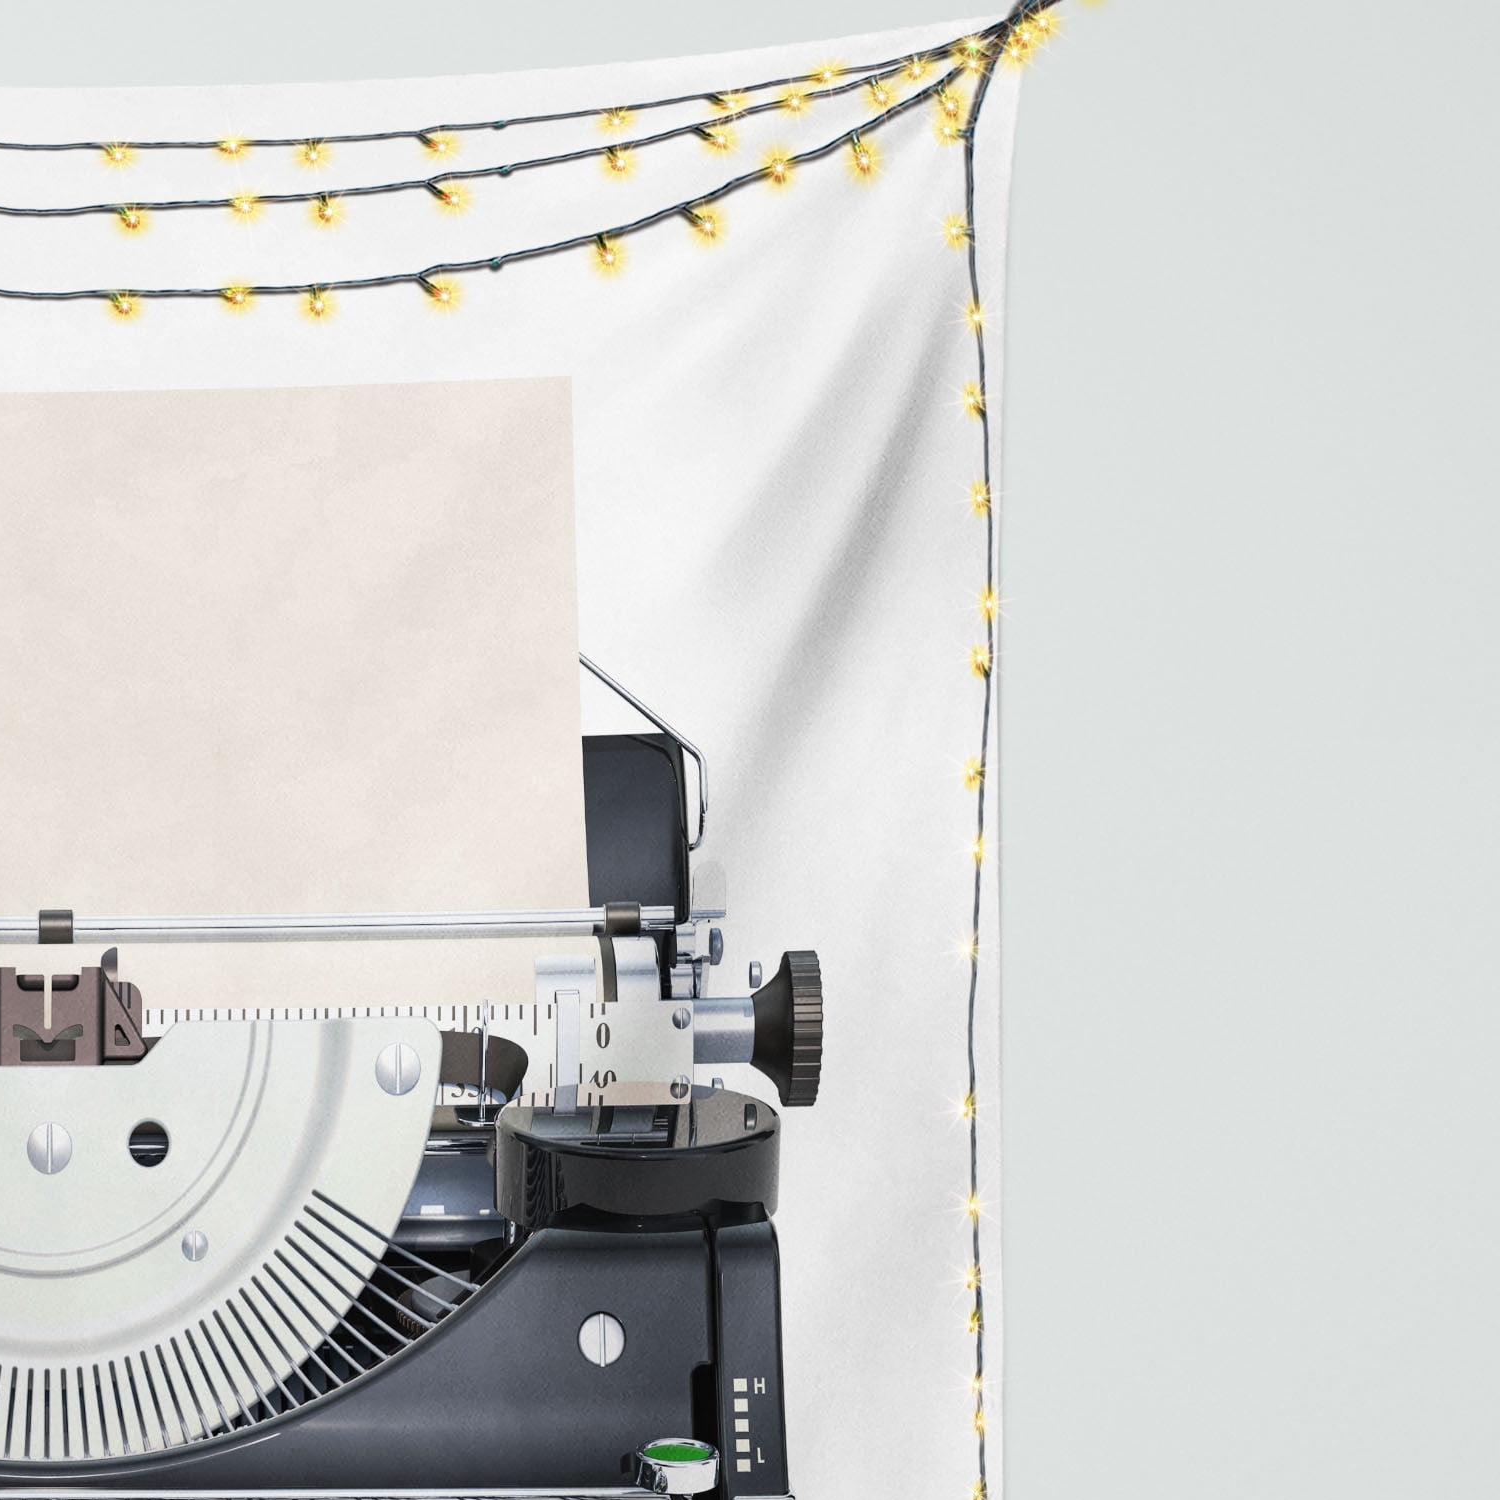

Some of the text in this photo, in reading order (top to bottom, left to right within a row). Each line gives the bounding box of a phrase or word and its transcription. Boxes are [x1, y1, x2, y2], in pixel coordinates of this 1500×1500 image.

[596, 1022, 611, 1048] 0
[753, 1377, 766, 1394] H
[756, 1447, 765, 1464] L
